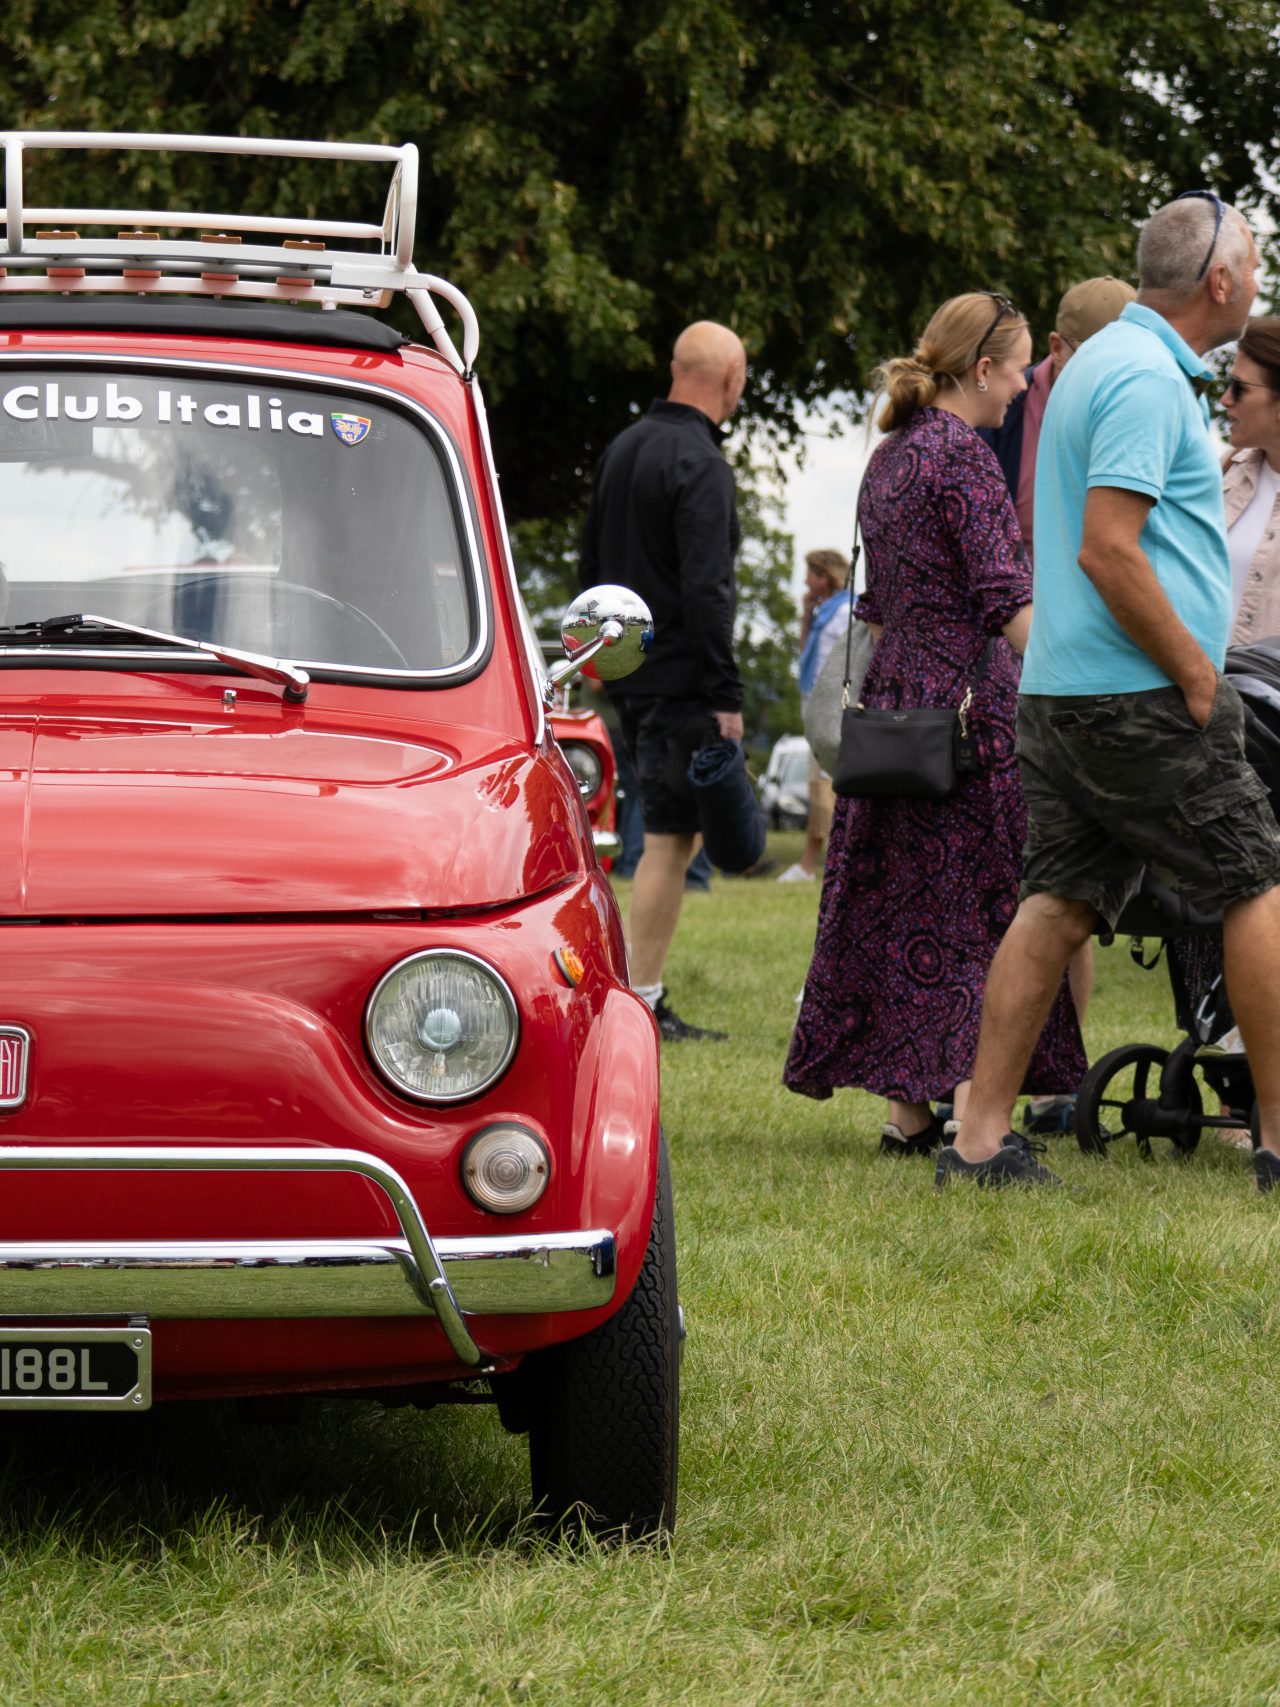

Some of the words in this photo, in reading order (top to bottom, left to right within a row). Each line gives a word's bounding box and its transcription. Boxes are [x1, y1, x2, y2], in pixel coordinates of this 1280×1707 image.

[3, 383, 143, 421] Club
[158, 390, 324, 436] Italia
[1, 1348, 109, 1391] 188L
